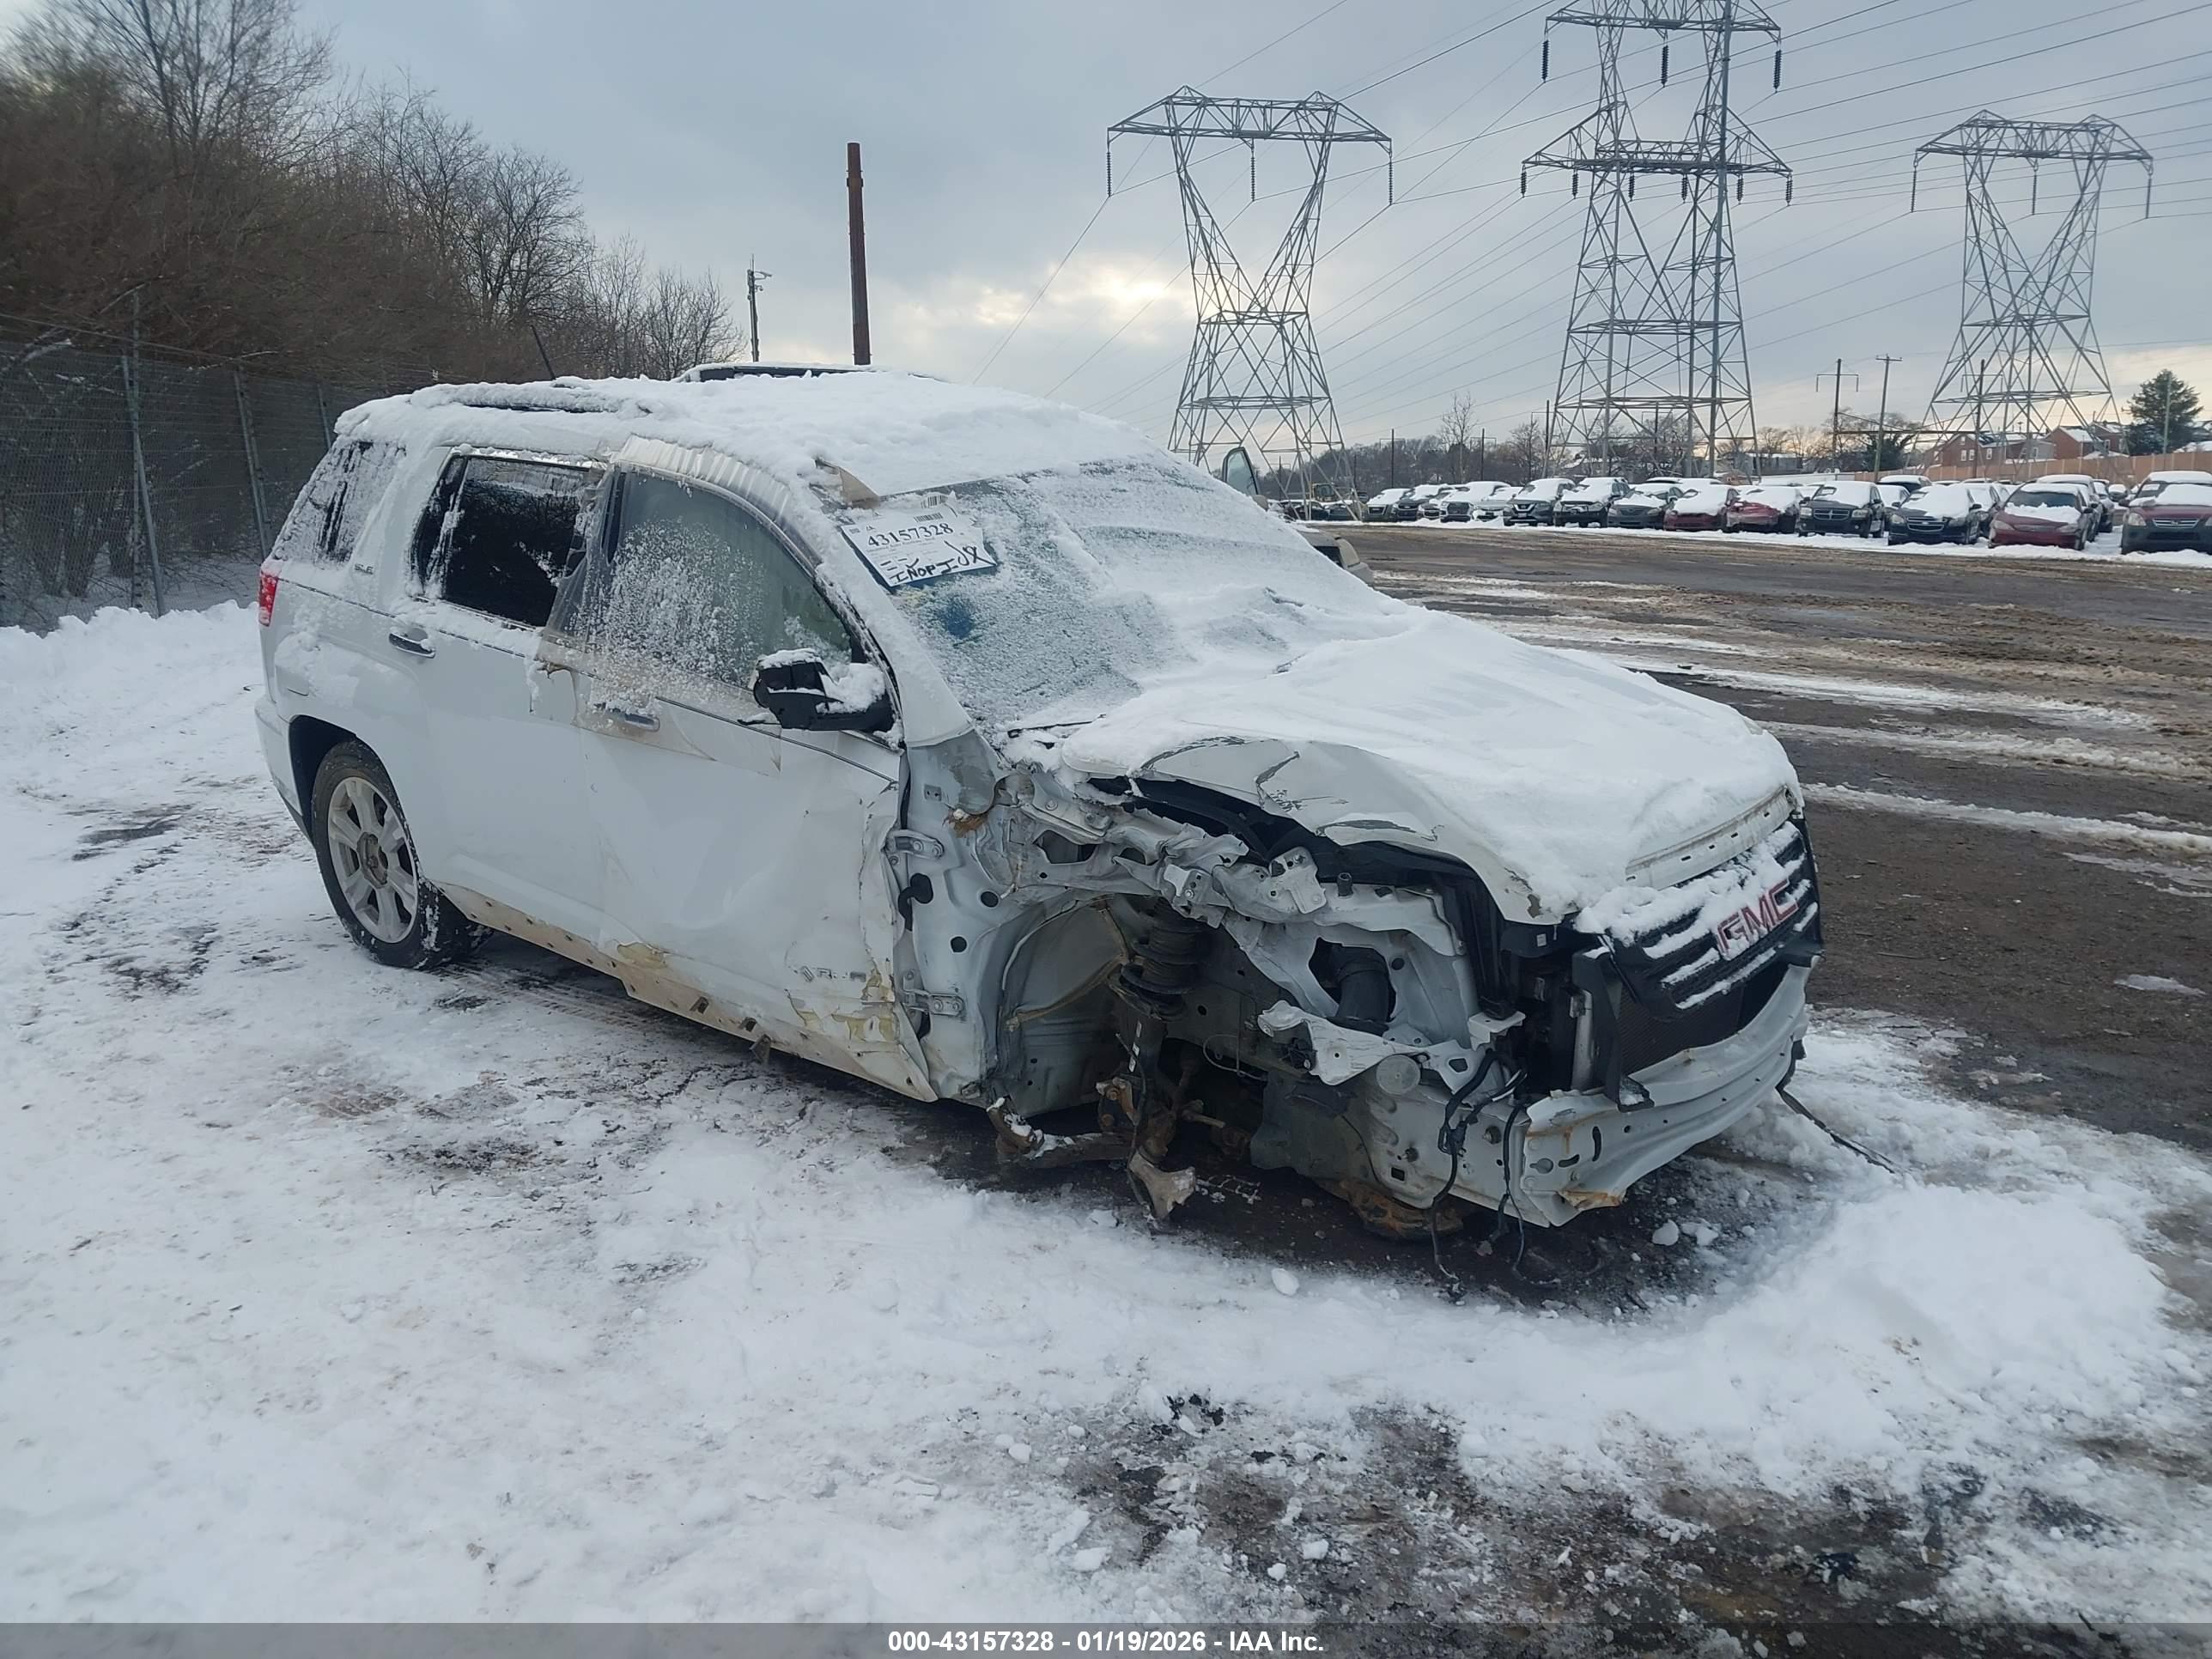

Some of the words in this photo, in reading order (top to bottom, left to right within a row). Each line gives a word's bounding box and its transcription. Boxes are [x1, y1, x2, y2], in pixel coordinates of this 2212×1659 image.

[867, 522, 954, 547] 43157328
[889, 564, 936, 583] INOP
[1716, 878, 1800, 961] GMC
